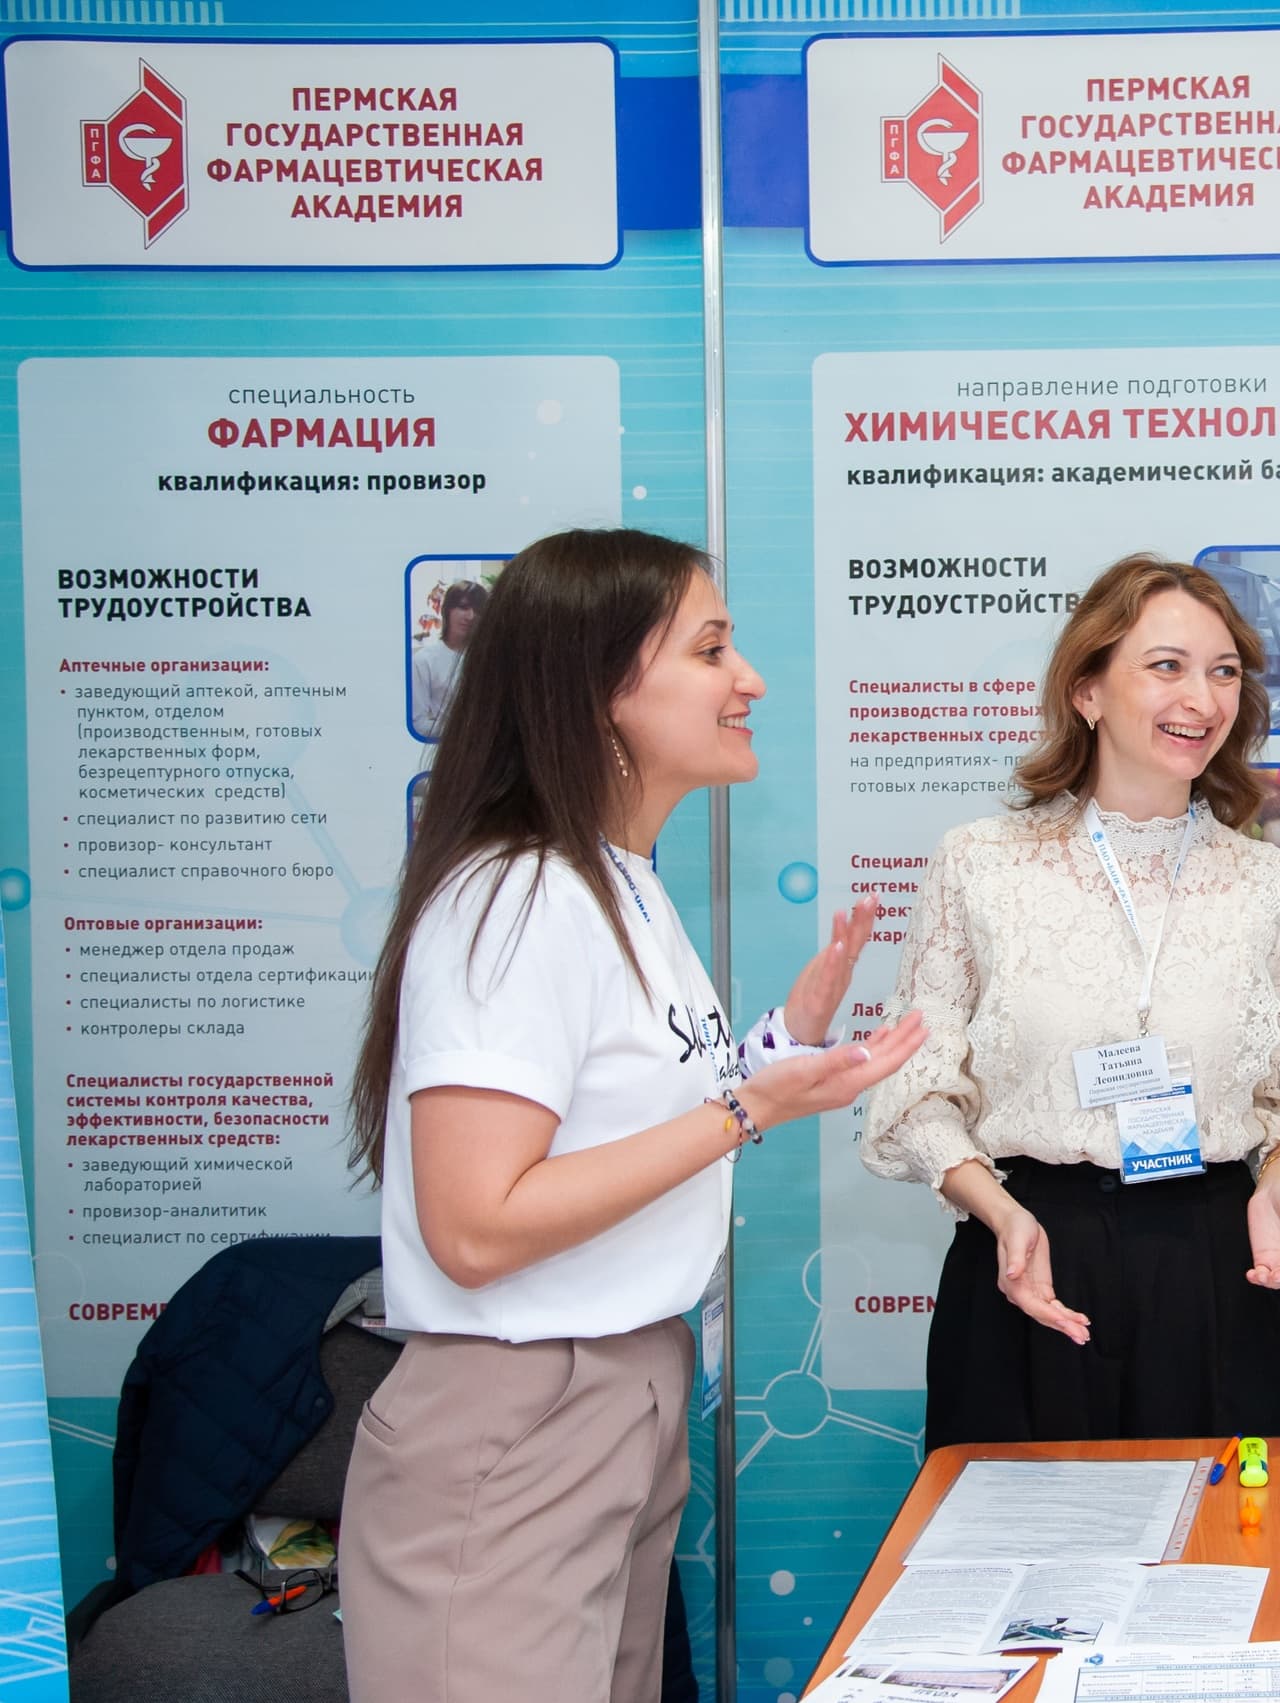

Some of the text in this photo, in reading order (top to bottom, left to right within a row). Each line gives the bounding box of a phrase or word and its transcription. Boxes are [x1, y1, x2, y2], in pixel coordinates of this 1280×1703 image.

[1087, 74, 1250, 103] ПЕРМСКАЯ
[292, 87, 457, 112] ПЕРМСКАЯ
[226, 122, 523, 152] ГОСУДАРСТВЕННАЯ
[90, 127, 101, 180] ПГФА
[888, 123, 901, 176] ПГФА
[206, 157, 543, 188] ФАРМАЦЕВТИЧЕСКАЯ
[1082, 182, 1254, 213] АКАДЕМИЯ
[290, 194, 463, 223] АКАДЕМИЯ
[228, 388, 415, 409] специальность
[957, 377, 1267, 403] направление подготовки
[207, 417, 436, 454] ФАРМАЦИЯ
[844, 409, 1111, 443] ХИМИЧЕСКАЯ
[158, 470, 486, 496] квалификация: провизор
[847, 463, 1044, 489] квалификация:
[1051, 459, 1253, 486] академический
[848, 556, 1047, 580] ВОЗМОЖНОСТИ
[58, 568, 259, 590] ВОЗМОЖНОСТИ
[57, 591, 312, 622] ТРУДОУСТРОЙСТВА
[849, 589, 1079, 618] ТРУДОУСТРОЙСТВ
[59, 658, 269, 676] Аптечные организации:
[74, 683, 347, 702] заведующий аптекой, аптечным
[849, 678, 1036, 696] Специалисты в сфере
[77, 706, 224, 723] пунктом, отделом
[849, 704, 1042, 721] производства готовых
[77, 722, 322, 743] (производственным, готовых
[848, 730, 984, 746] лекарственных
[77, 743, 261, 763] лекарственных форм,
[78, 763, 295, 783] безрецептурного отпуска,
[850, 756, 869, 768] на
[874, 755, 999, 772] предприятиях-
[79, 781, 286, 802] косметических средств)
[850, 781, 916, 793] готовых
[77, 813, 327, 829] специалист по развитию сети
[78, 839, 273, 856] провизор- консультант
[78, 862, 334, 881] специалист справочного бюро
[63, 916, 263, 934] Оптовые организации:
[79, 944, 295, 960] менеджер отдела продаж
[79, 971, 191, 985] специалисты
[195, 970, 253, 985] отдела
[79, 996, 306, 1012] специалисты по логистике
[80, 1023, 245, 1039] контролеры склада
[66, 1072, 334, 1090] Специалисты государственной
[66, 1095, 313, 1110] системы контроля качества,
[66, 1111, 329, 1130] эффективности, безопасности
[65, 1133, 280, 1149] лекарственных средств:
[81, 1156, 293, 1176] заведующий химической
[1132, 1153, 1193, 1171] УЧАСТНИК
[83, 1176, 202, 1196] лабораторией
[82, 1206, 267, 1222] провизор-аналититик
[82, 1232, 182, 1247] специалист
[186, 1232, 206, 1244] по
[855, 1296, 936, 1313] СОВРЕМ
